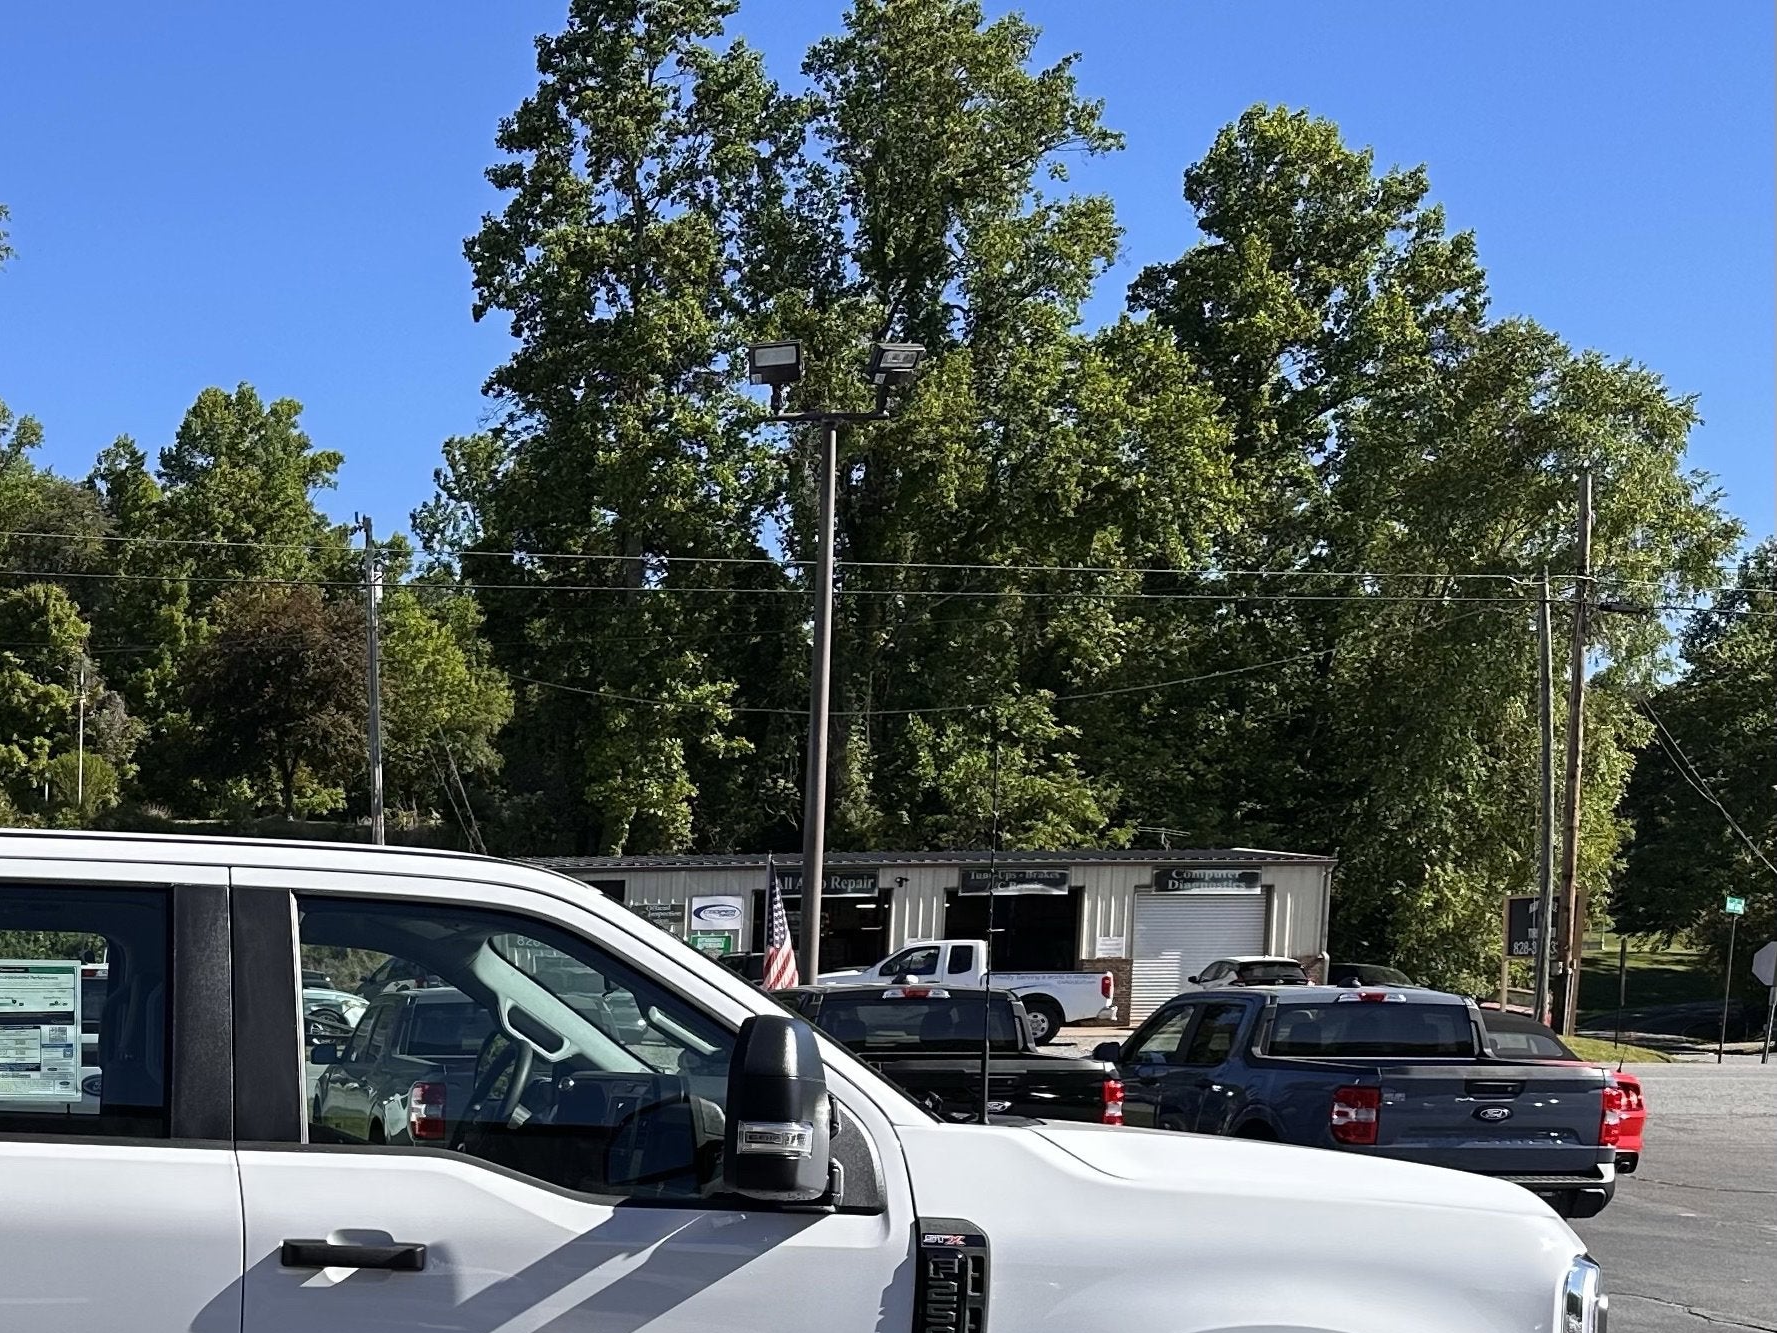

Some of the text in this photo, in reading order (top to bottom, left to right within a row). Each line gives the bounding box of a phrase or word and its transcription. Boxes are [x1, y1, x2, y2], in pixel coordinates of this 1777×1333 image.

[1025, 871, 1060, 880] Brakes
[1171, 869, 1240, 880] Computer
[830, 875, 874, 892] Repair
[1167, 880, 1247, 890] Diagnostics
[924, 1235, 966, 1246] STX
